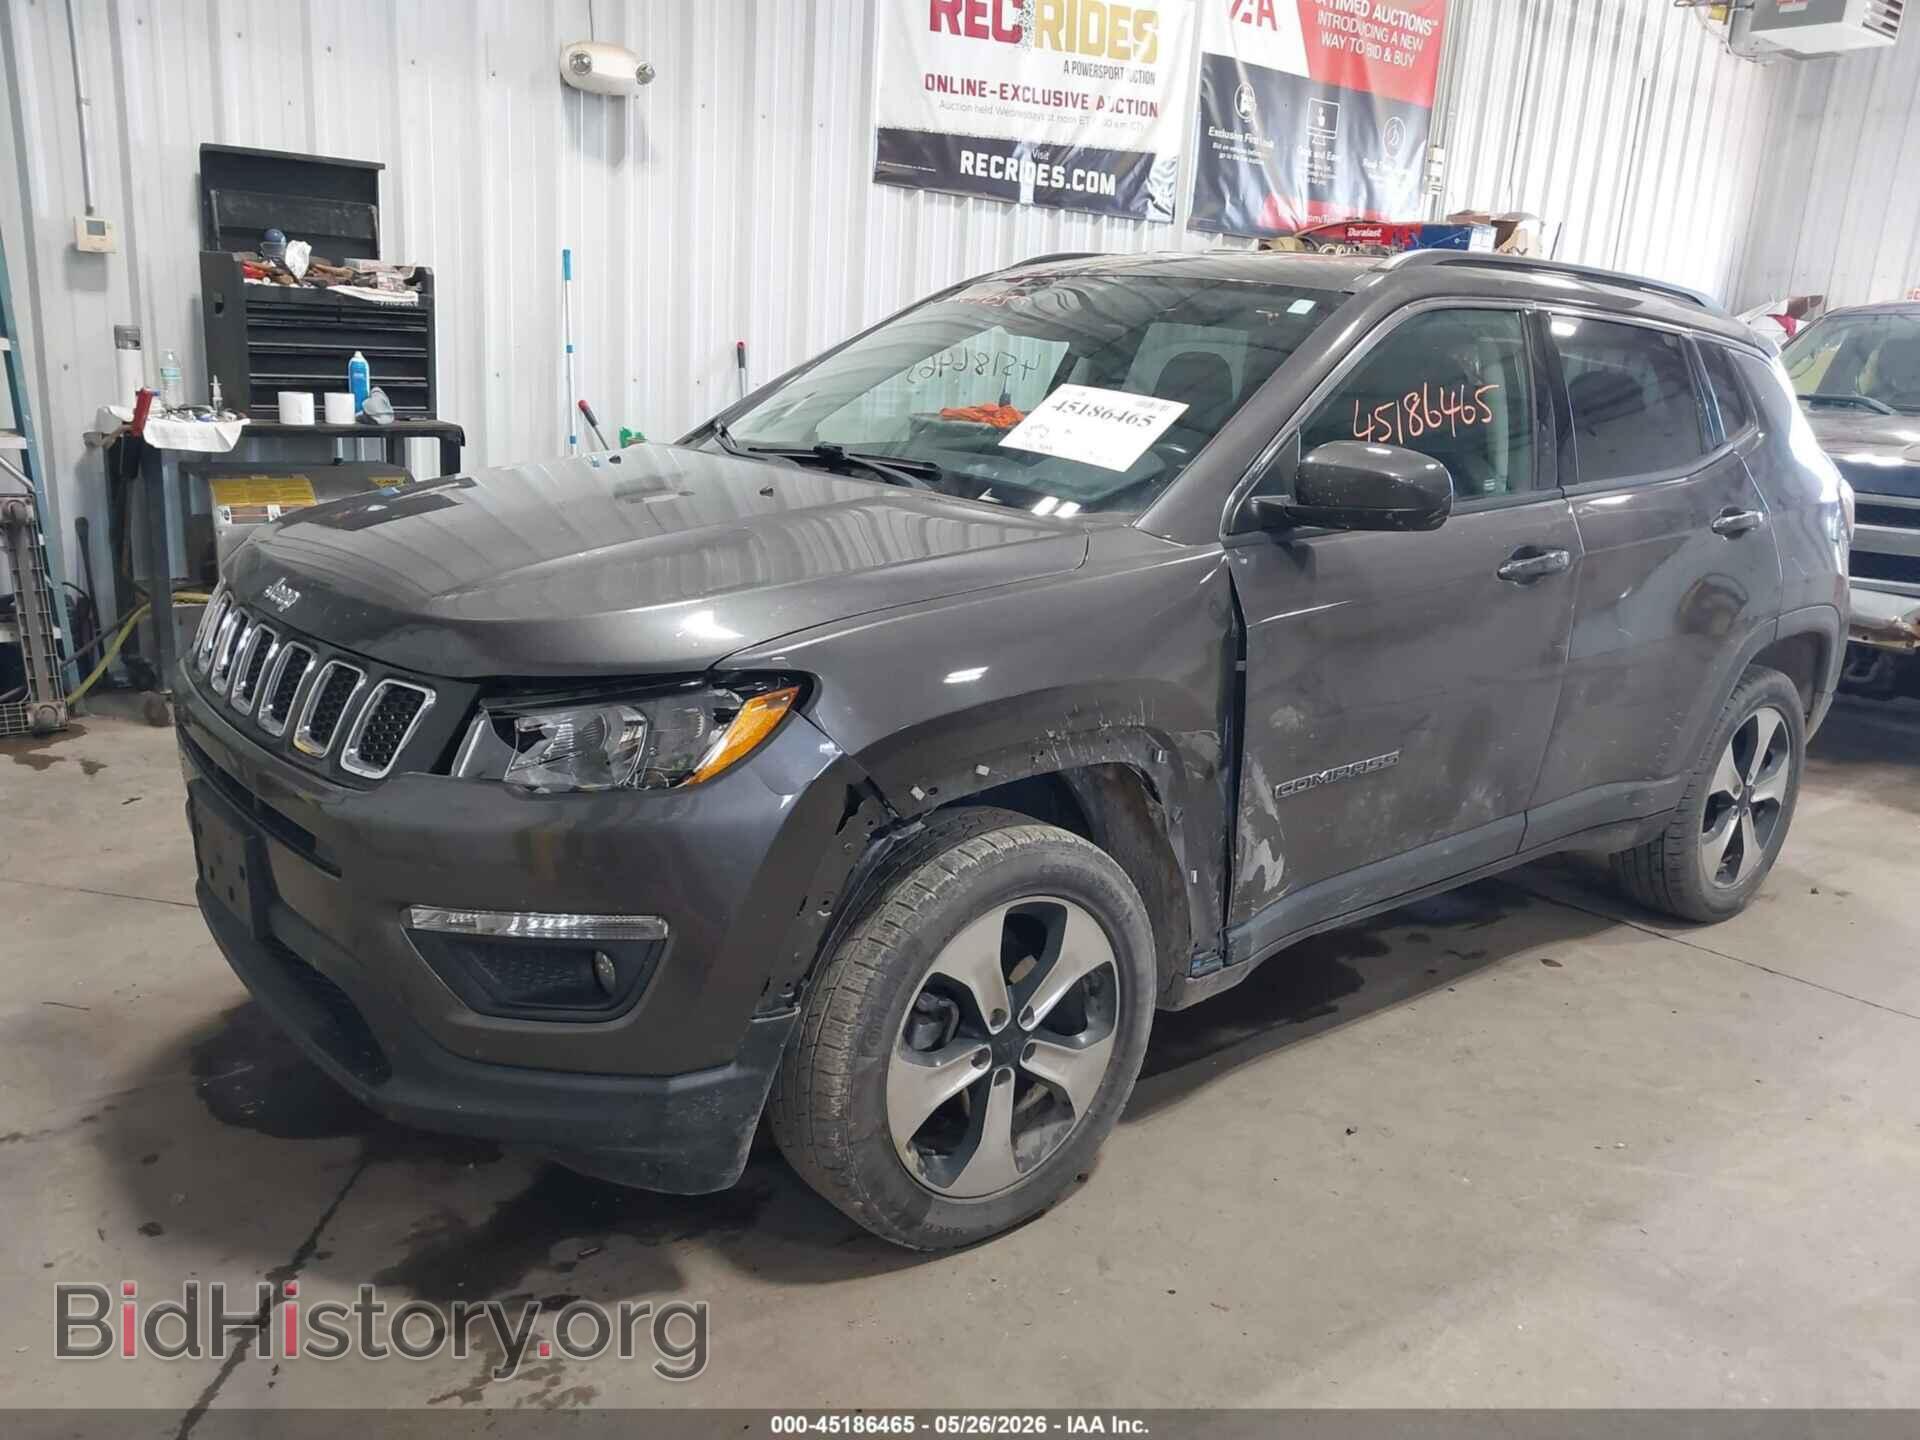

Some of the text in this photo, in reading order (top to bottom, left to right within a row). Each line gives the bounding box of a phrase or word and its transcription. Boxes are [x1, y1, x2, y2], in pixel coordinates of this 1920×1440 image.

[1034, 0, 1160, 64] RIDES
[1317, 10, 1424, 52] INTRODUCING A NEW
[1321, 30, 1347, 50] WAY
[1349, 36, 1365, 55] TO
[1383, 47, 1392, 62] &
[1394, 50, 1416, 68] BUY
[1063, 60, 1070, 75] A
[1071, 61, 1125, 80] POWERSPORT
[924, 73, 1089, 110] ONLINE-EXCLUSIVE
[960, 150, 1116, 196] RECRIDES.COM
[1032, 150, 1049, 161] Visit
[1346, 227, 1382, 238] Duralast
[1051, 399, 1157, 428] 45186465
[1352, 382, 1501, 445] 45186465
[264, 577, 302, 613] Jeep
[1274, 750, 1401, 800] COMPASS
